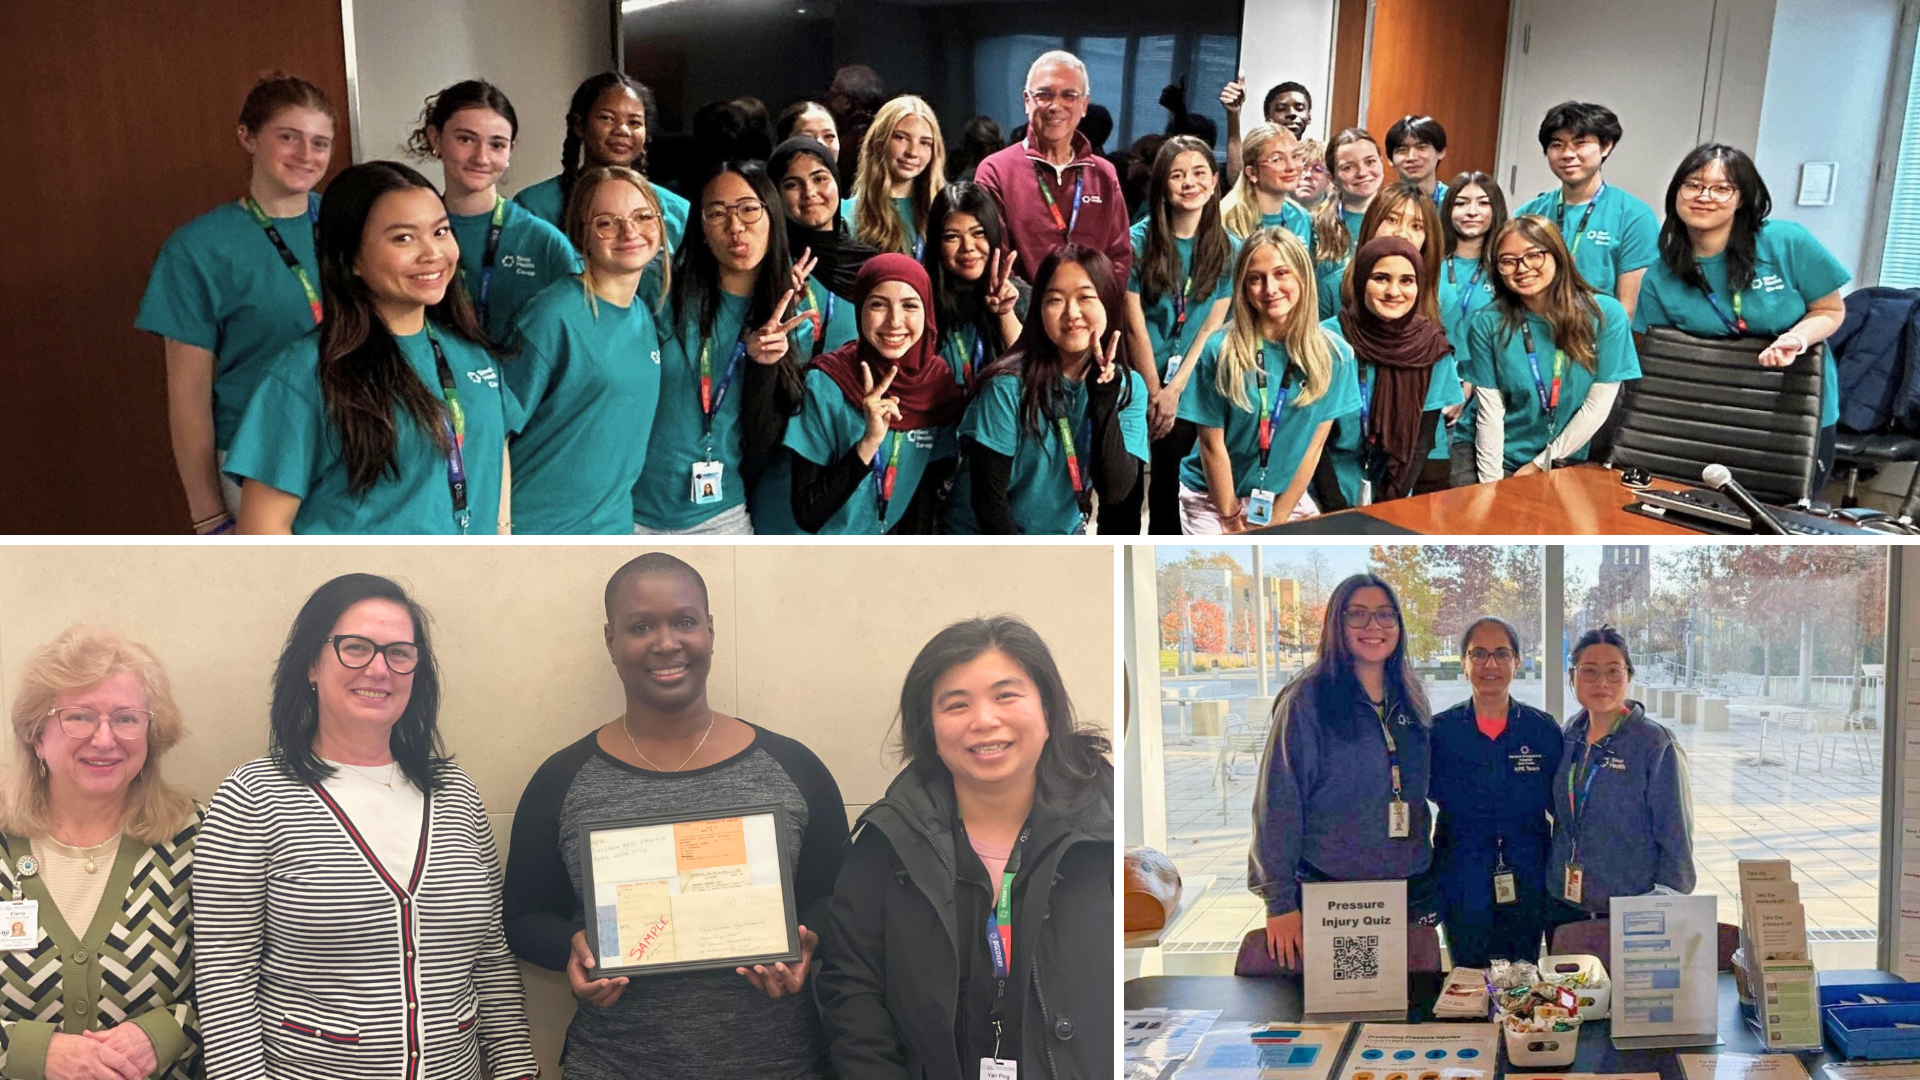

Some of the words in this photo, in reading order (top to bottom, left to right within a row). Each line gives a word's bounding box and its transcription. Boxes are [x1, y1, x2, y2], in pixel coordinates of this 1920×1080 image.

[1327, 901, 1385, 910] Pressure
[1321, 917, 1359, 928] Injury
[1363, 915, 1391, 925] Quiz
[629, 914, 669, 961] SAMPLE
